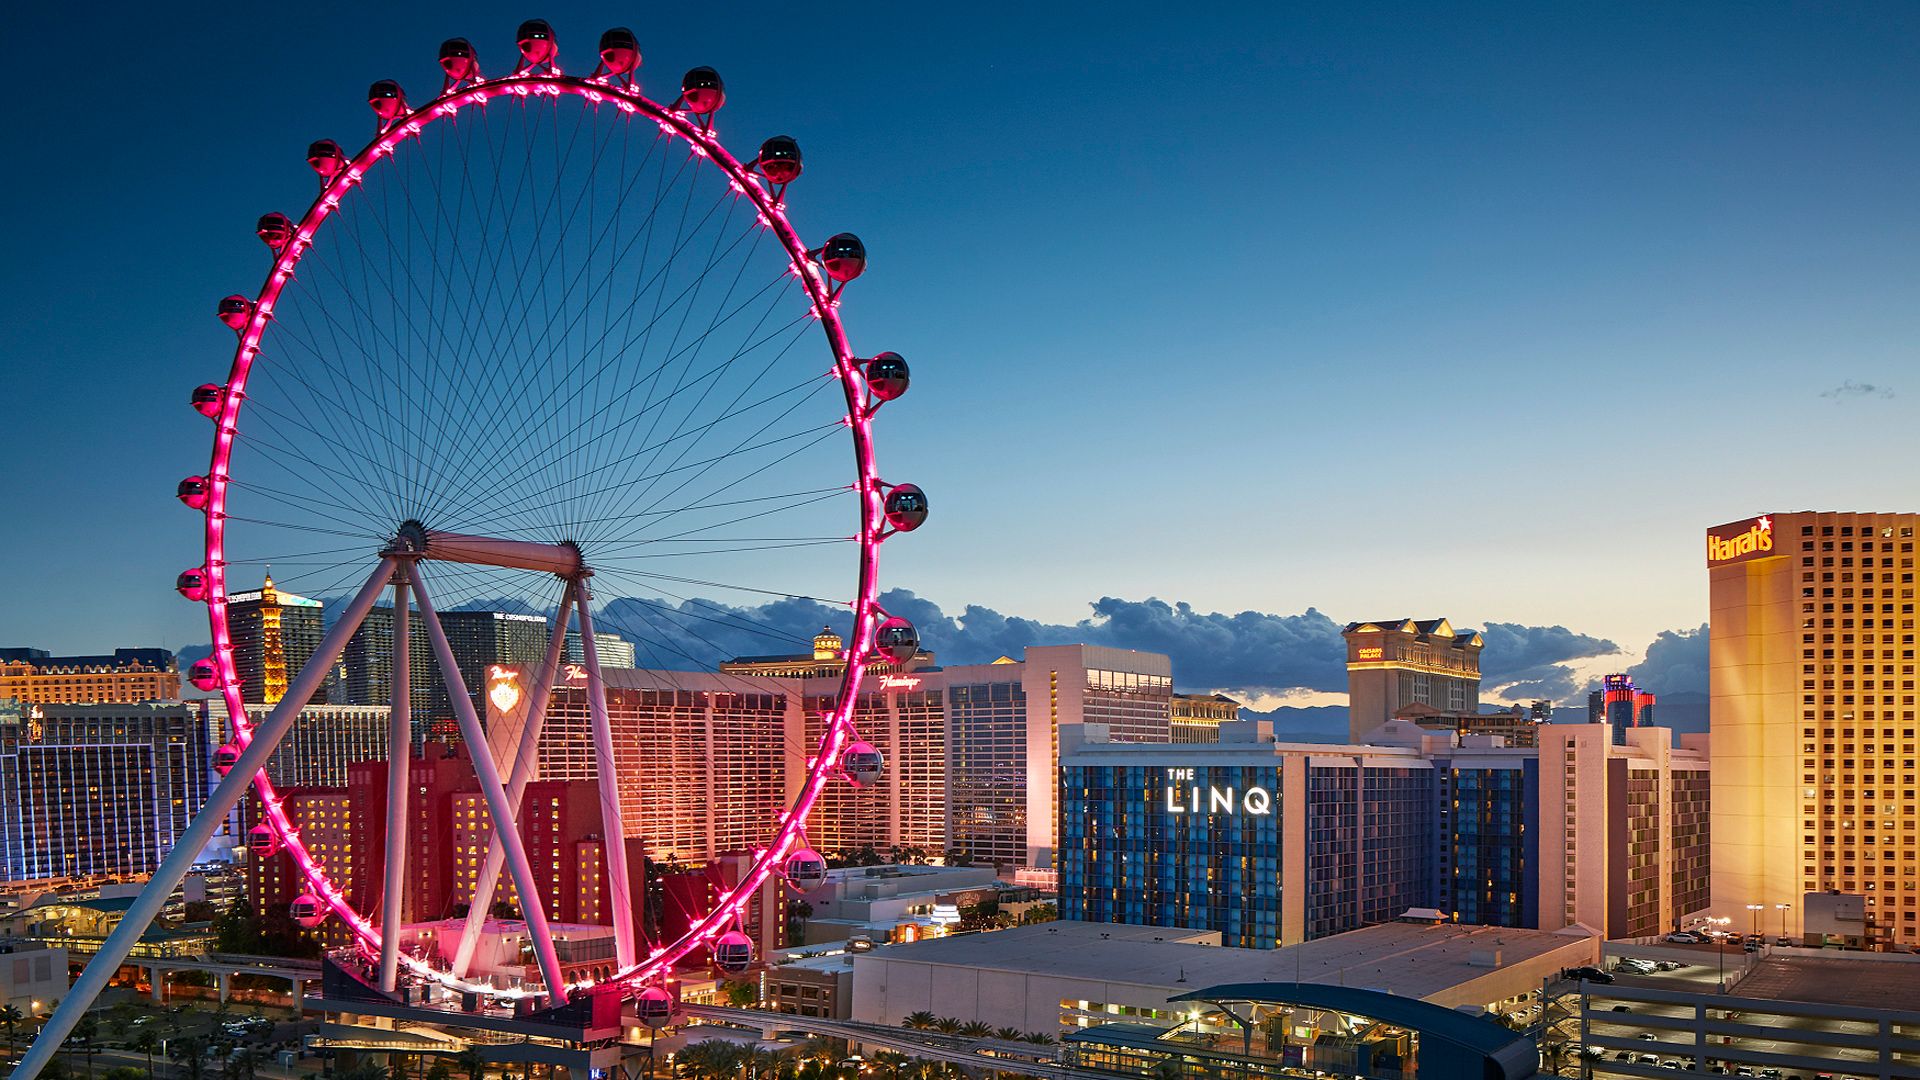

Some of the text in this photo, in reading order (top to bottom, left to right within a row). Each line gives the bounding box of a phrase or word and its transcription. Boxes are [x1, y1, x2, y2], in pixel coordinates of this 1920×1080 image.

[505, 613, 547, 623] COSMOPOLITAN
[879, 674, 921, 691] Flamingo
[1167, 768, 1194, 780] THE
[1167, 785, 1270, 815] LINQ
